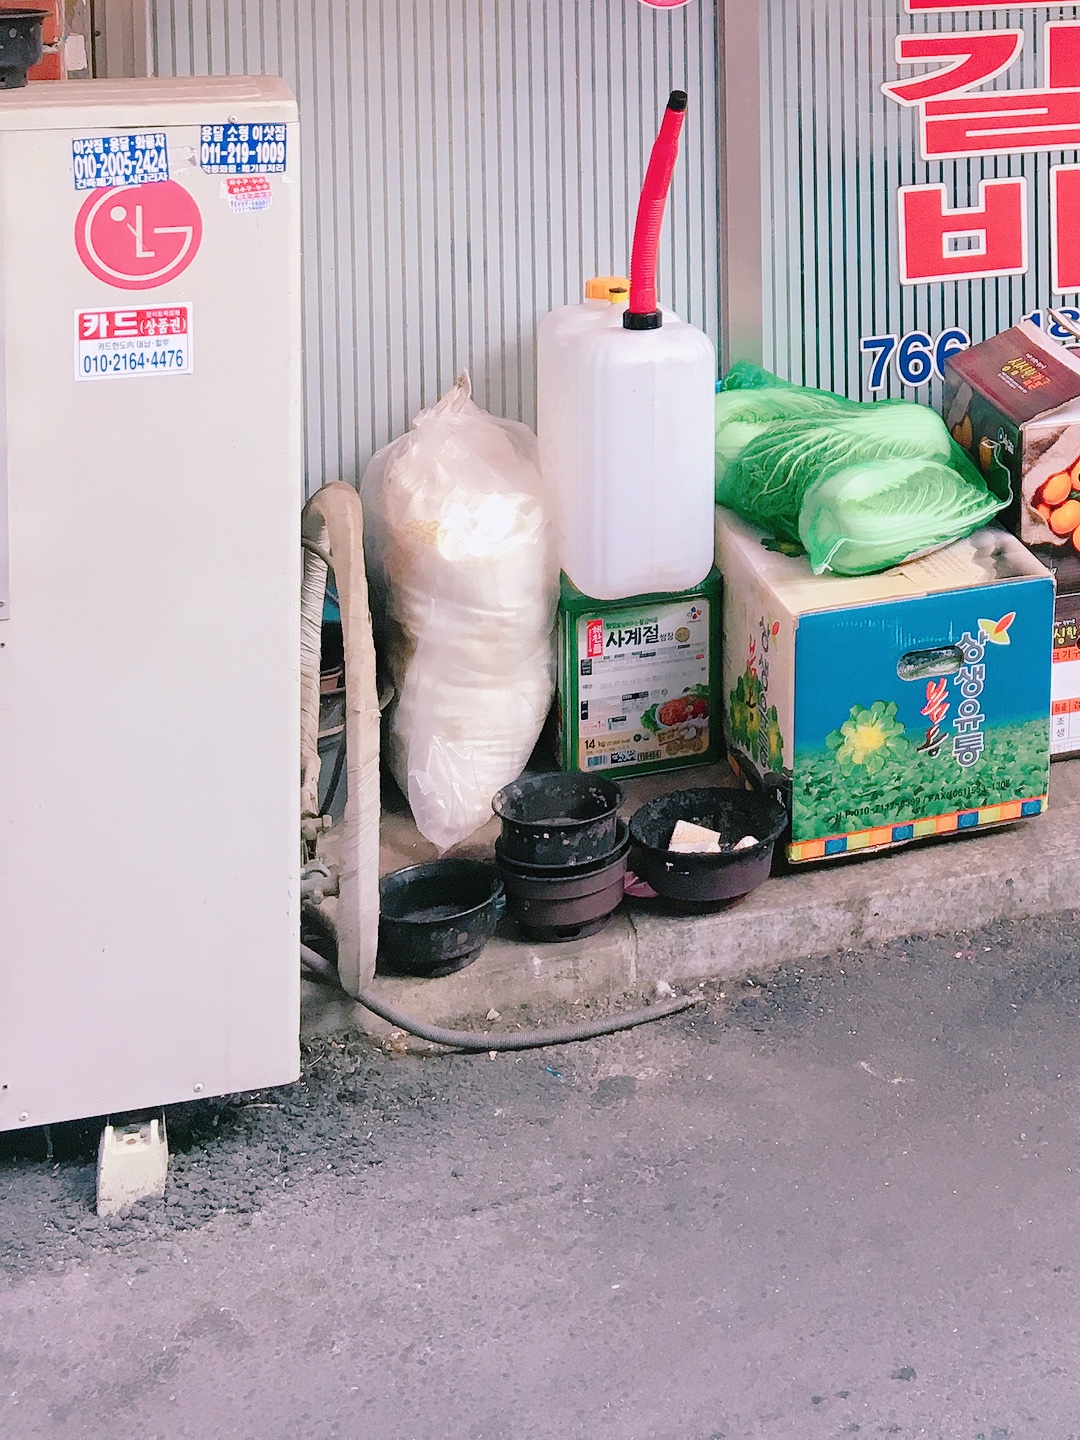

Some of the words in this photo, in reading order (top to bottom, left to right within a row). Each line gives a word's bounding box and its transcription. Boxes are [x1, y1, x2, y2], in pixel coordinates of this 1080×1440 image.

[202, 126, 224, 142] 용달
[227, 125, 249, 141] 소형
[252, 125, 286, 141] 이삿짐
[74, 149, 167, 180] 010-2005-2424
[201, 142, 285, 164] 011-219-1009
[83, 311, 138, 337] 카드
[140, 317, 187, 336] (상품권)
[605, 624, 660, 648] 사계절
[660, 632, 674, 642] 쌈장
[953, 629, 990, 767] 상생유통
[585, 739, 595, 750] 14
